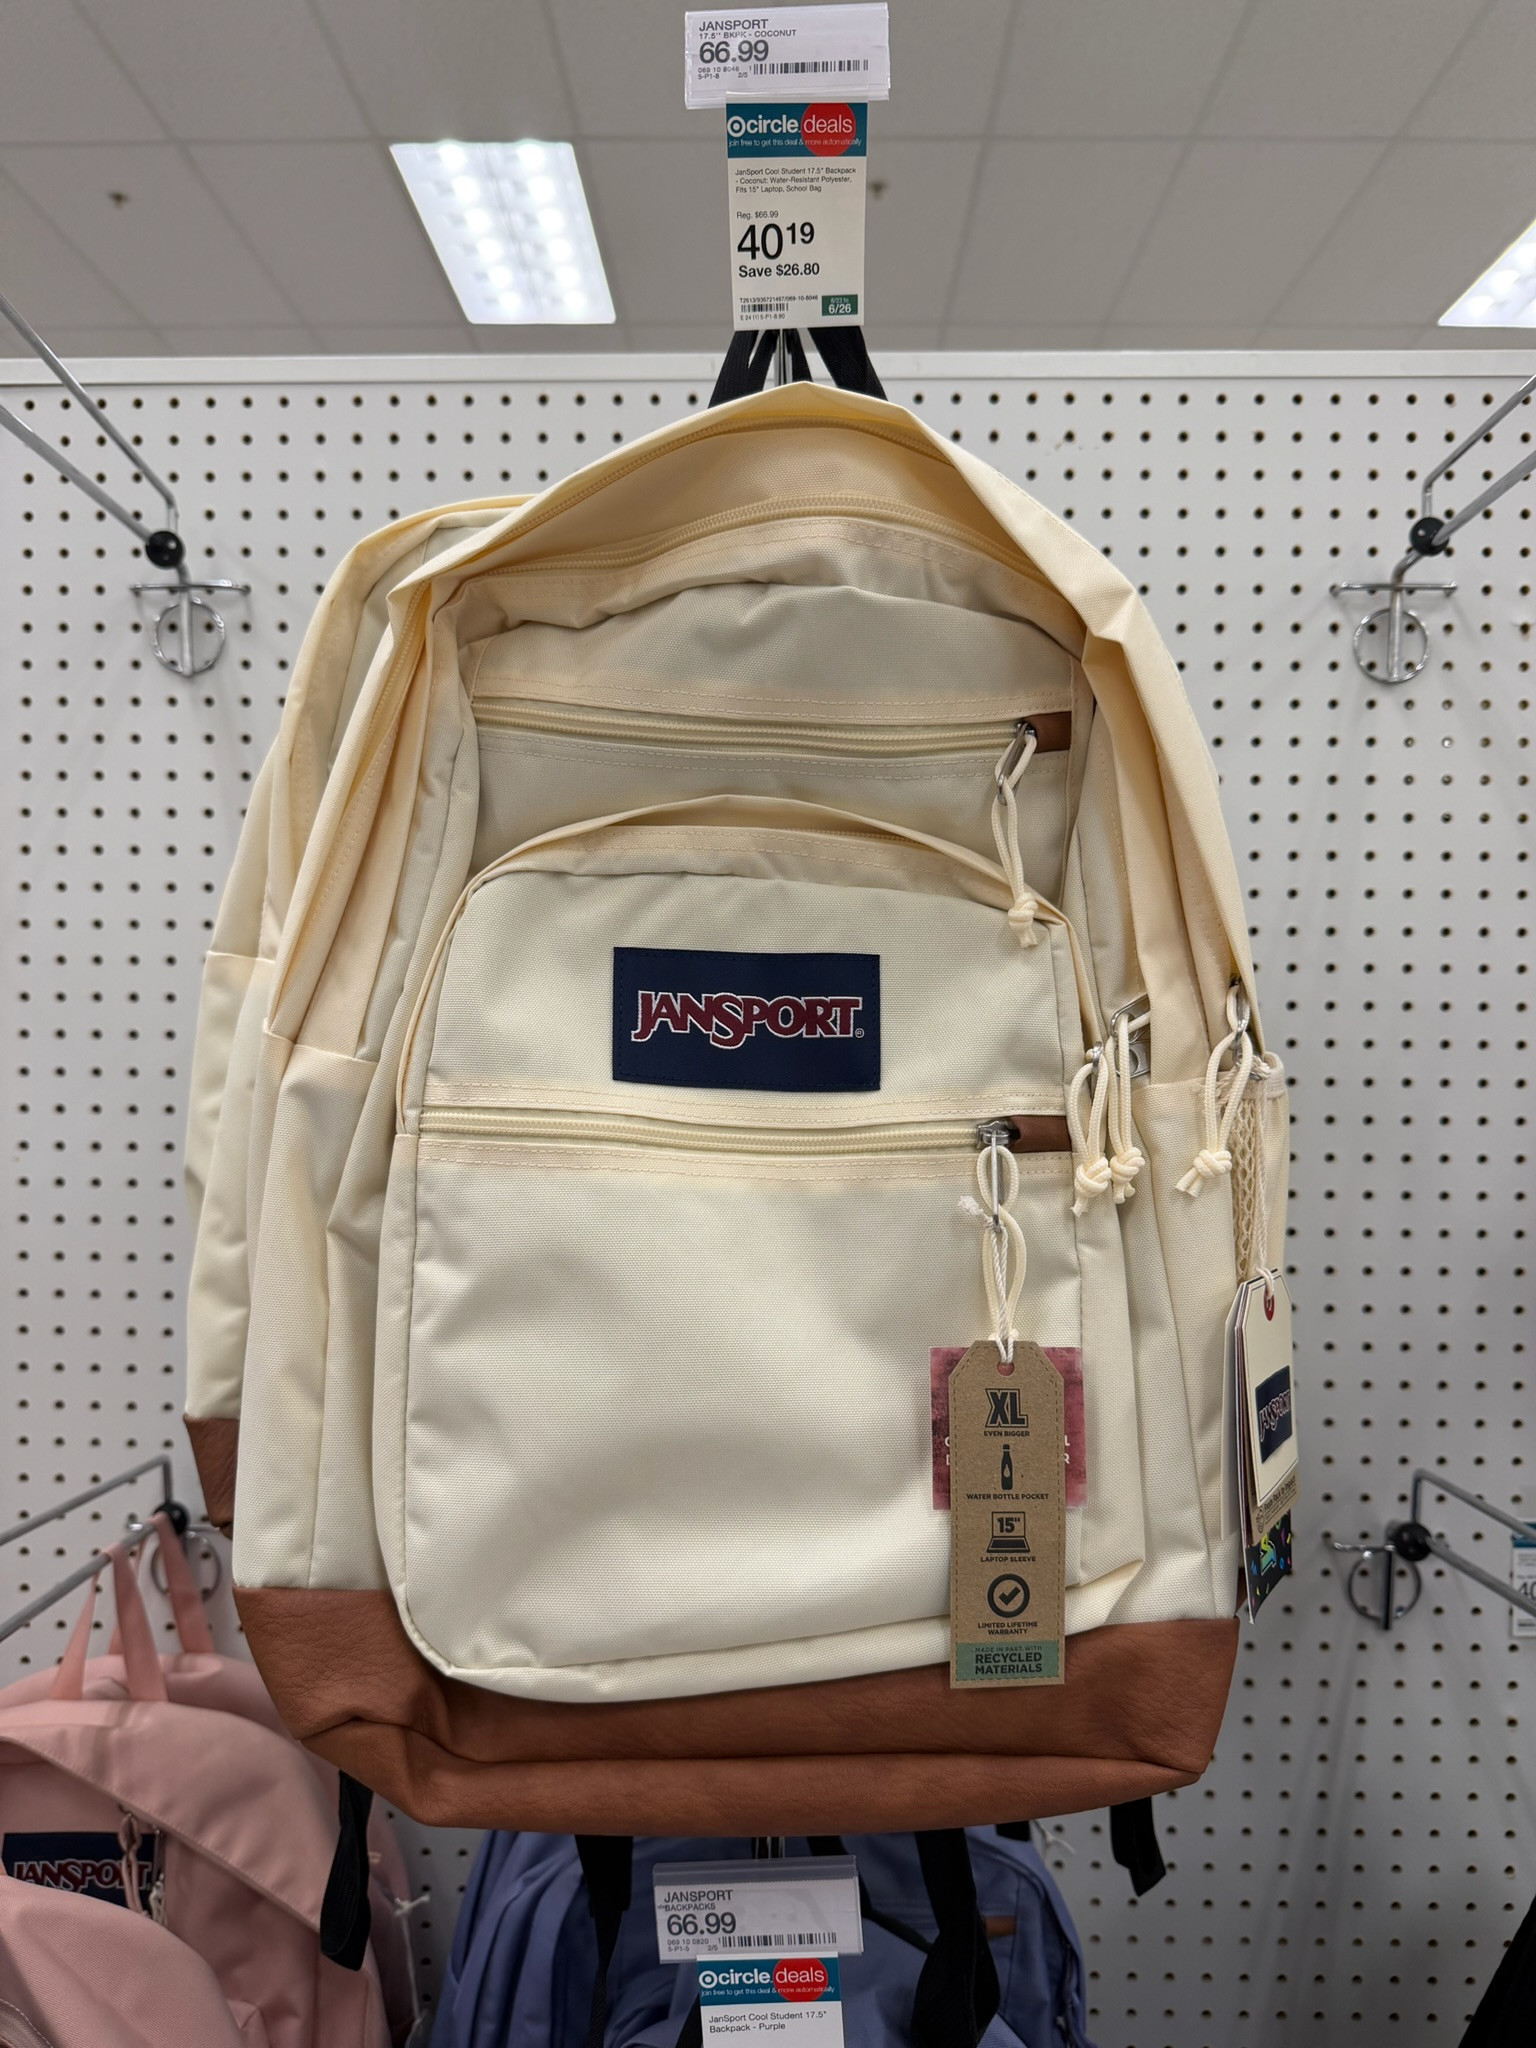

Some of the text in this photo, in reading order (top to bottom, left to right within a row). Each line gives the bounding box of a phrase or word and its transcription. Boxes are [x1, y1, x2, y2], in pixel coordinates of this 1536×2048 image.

[699, 19, 769, 32] JANSPORT
[724, 31, 747, 39] BKPK
[754, 29, 797, 37] COCONUT
[700, 39, 769, 63] 66.99
[803, 114, 853, 134] deals
[728, 139, 740, 148] join
[741, 138, 753, 146] free
[761, 139, 772, 148] get
[773, 138, 784, 146] this
[784, 138, 798, 146] deal
[799, 138, 804, 146] &
[822, 137, 862, 147] automatically
[735, 168, 764, 176] JanSport
[765, 168, 780, 176] Cool
[781, 167, 806, 175] Student
[825, 167, 857, 175] Backpack
[770, 176, 820, 184] Water-Resistant
[735, 186, 748, 194] Fits
[760, 186, 785, 194] Laptop,
[809, 185, 822, 193] Bag
[736, 211, 779, 220] Reg. $66.99
[738, 263, 820, 278] Save $26.80
[828, 303, 852, 314] 6/26
[631, 990, 863, 1050] JANSPORT
[985, 1388, 1028, 1428] XL
[997, 1517, 1021, 1533] 15"
[975, 1652, 1042, 1664] RECYCLED
[975, 1663, 1042, 1675] MATERIALS
[664, 1889, 733, 1903] JANSPORT
[665, 1903, 716, 1911] BACKPACKS
[667, 1912, 736, 1936] 66.99
[775, 1967, 825, 1983] deals
[796, 1986, 835, 1994] automatically
[709, 2014, 746, 2024] JanSport
[749, 2013, 768, 2022] Cool
[771, 2011, 803, 2021] Student
[710, 2024, 750, 2033] Backpack
[759, 2022, 786, 2032] Purple
